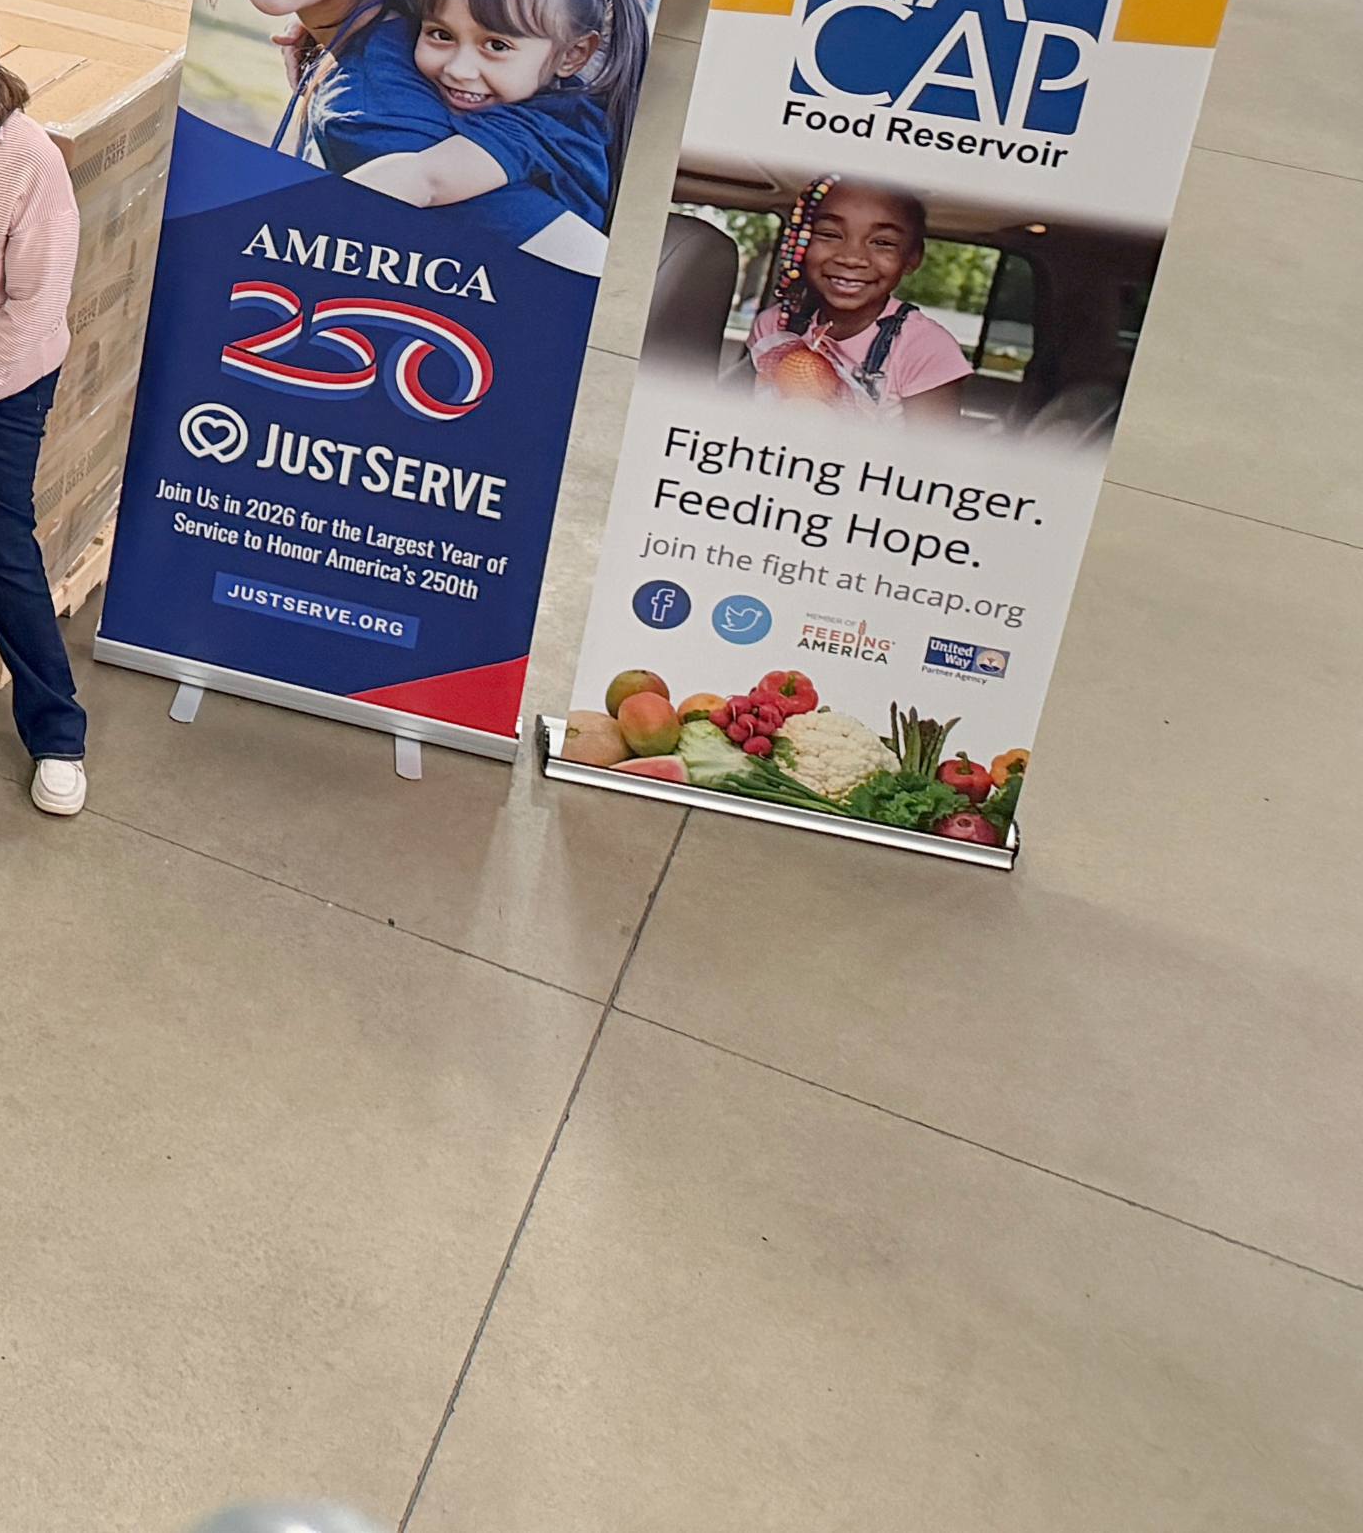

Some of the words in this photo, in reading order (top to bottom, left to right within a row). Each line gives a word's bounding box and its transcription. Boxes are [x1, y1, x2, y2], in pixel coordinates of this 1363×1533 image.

[782, 100, 873, 139] Food
[885, 115, 1068, 169] Reservoir
[242, 224, 497, 304] AMERICA
[221, 280, 493, 423] 250
[664, 426, 845, 495] Fighting
[858, 461, 1043, 526] Hunger.
[156, 478, 192, 504] Join
[197, 486, 220, 511] Us
[224, 492, 241, 515] in
[245, 498, 295, 528] 2026
[301, 511, 328, 535] for
[332, 517, 362, 543] the
[366, 525, 436, 561] Largest
[440, 539, 482, 572] Year
[486, 553, 508, 577] of
[173, 512, 239, 547] Service
[244, 528, 262, 550] to
[267, 533, 320, 564] Honor
[420, 567, 479, 600] 250th
[654, 478, 832, 548] Feeding
[846, 514, 981, 568] Hope.
[227, 582, 404, 637] JUSTSERVE.ORG
[640, 532, 696, 562] join
[706, 545, 753, 572] the
[762, 553, 828, 587] fight
[836, 568, 867, 593] at
[875, 573, 1027, 629] hacap.org
[797, 637, 888, 665] AMERICA
[802, 623, 891, 651] FEEDING
[930, 639, 974, 657] United
[944, 652, 972, 670] Way
[921, 665, 953, 679] Partner
[954, 671, 988, 686] Agency
